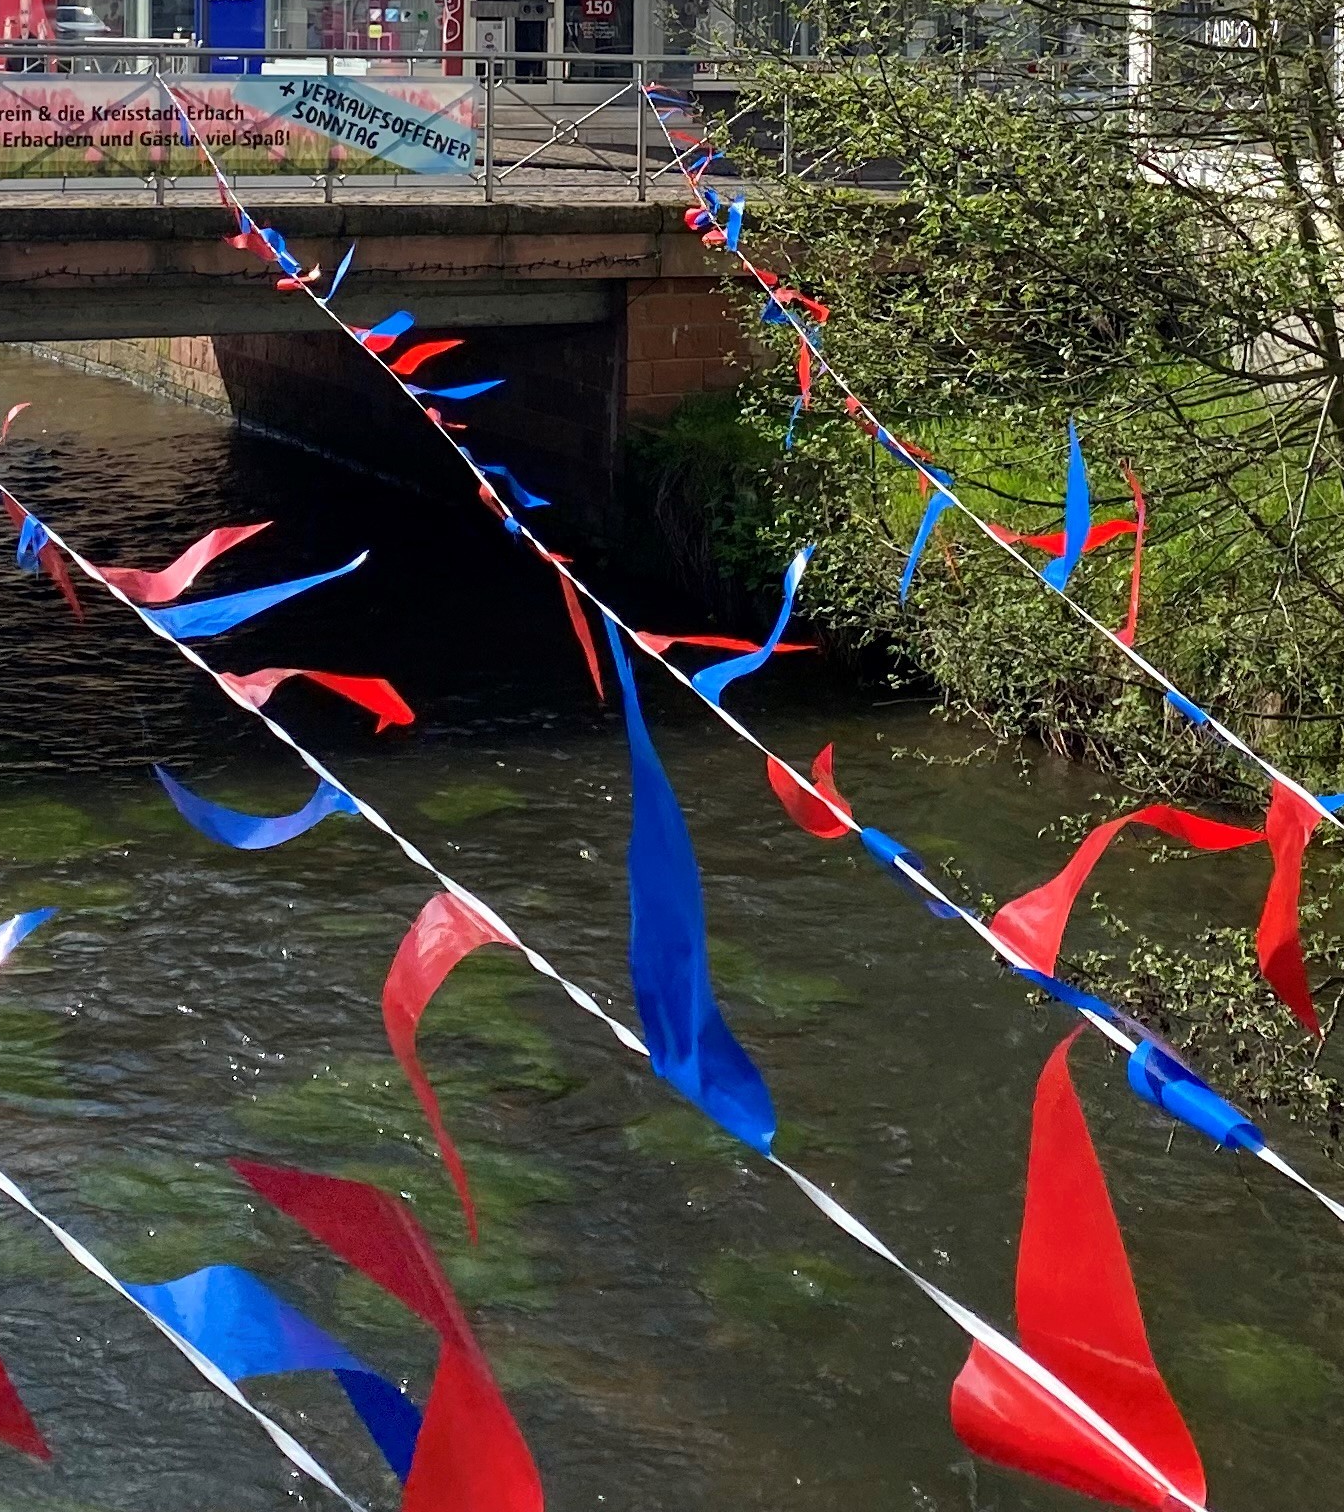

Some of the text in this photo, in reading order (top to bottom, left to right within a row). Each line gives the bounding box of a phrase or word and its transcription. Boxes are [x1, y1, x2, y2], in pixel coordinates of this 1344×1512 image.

[585, 0, 613, 15] 150
[38, 105, 52, 122] &
[58, 104, 85, 121] die
[91, 104, 181, 121] Kreisstadt
[186, 104, 244, 121] Erbach
[302, 79, 471, 162] VERKAUFSOFFENER
[292, 100, 380, 150] SONNTAG
[3, 130, 94, 148] Erbachern
[100, 130, 133, 147] und
[207, 130, 235, 146] viel
[239, 130, 290, 150] Spaß!
